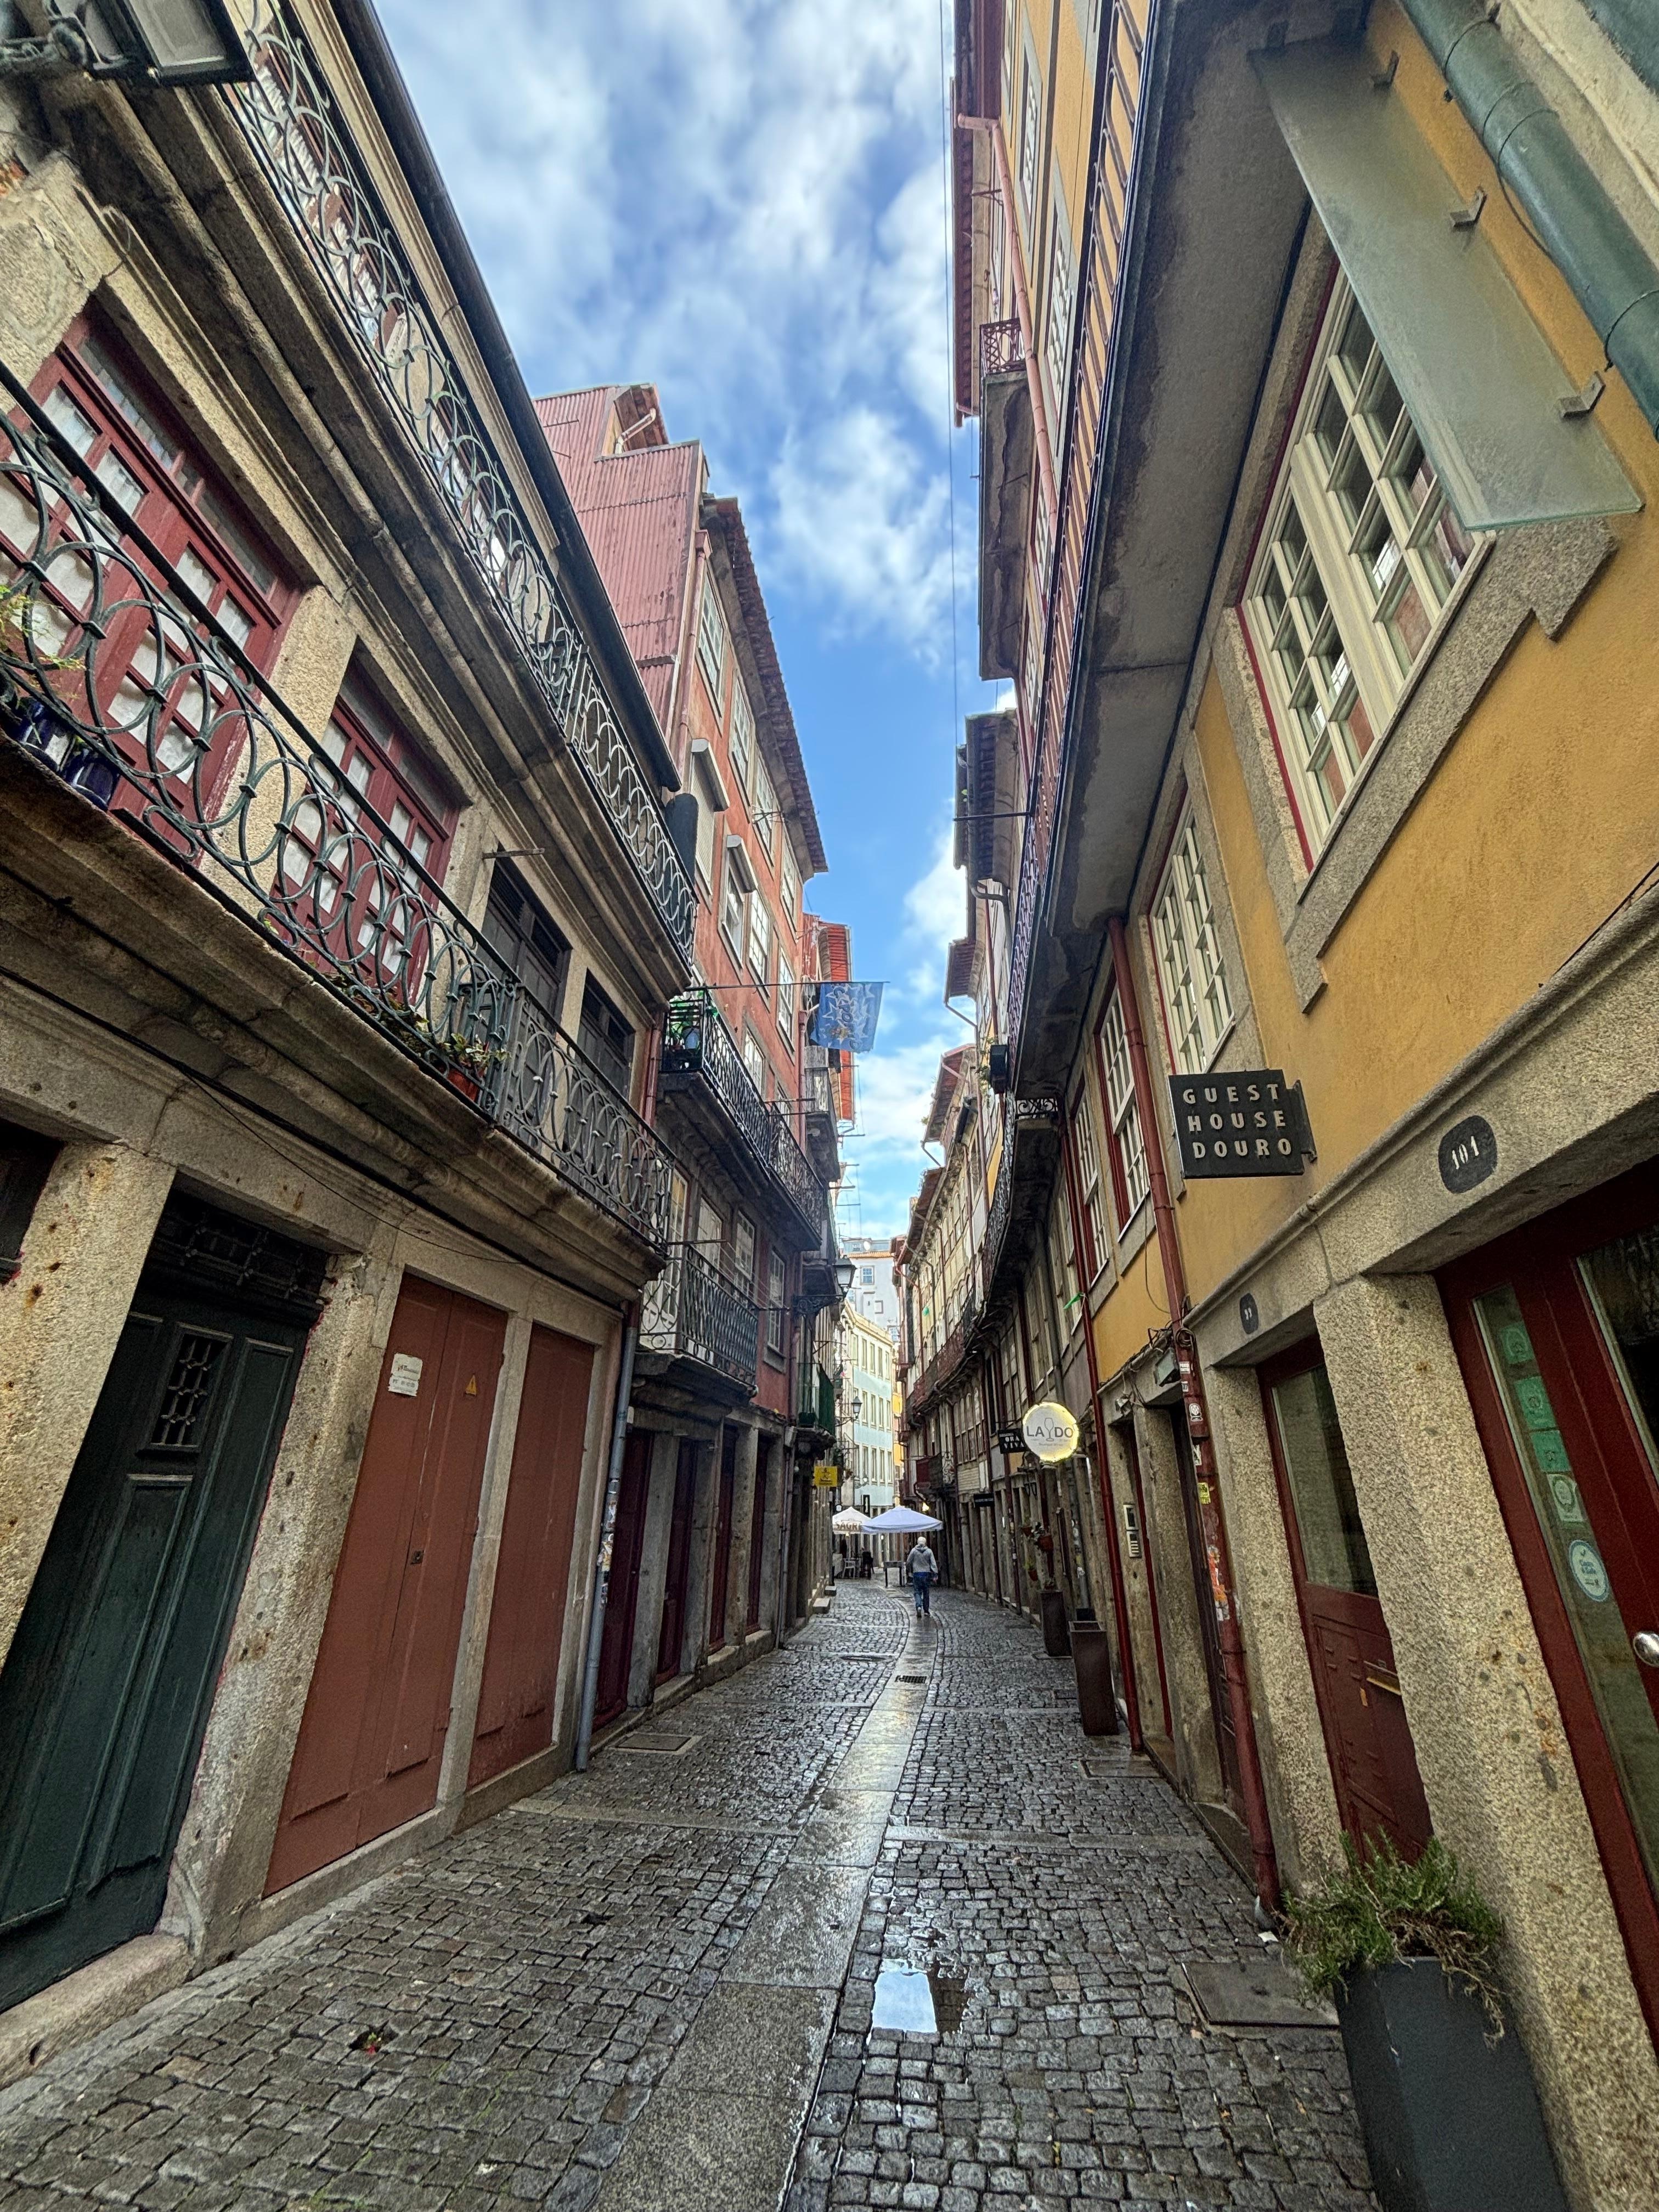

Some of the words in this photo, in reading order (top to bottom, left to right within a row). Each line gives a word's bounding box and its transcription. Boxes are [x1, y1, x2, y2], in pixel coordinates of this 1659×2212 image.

[1183, 1084, 1278, 1104] GUEST
[1187, 1110, 1285, 1132] HOUSE
[1193, 1138, 1291, 1159] DOURO
[1452, 1136, 1479, 1170] 101
